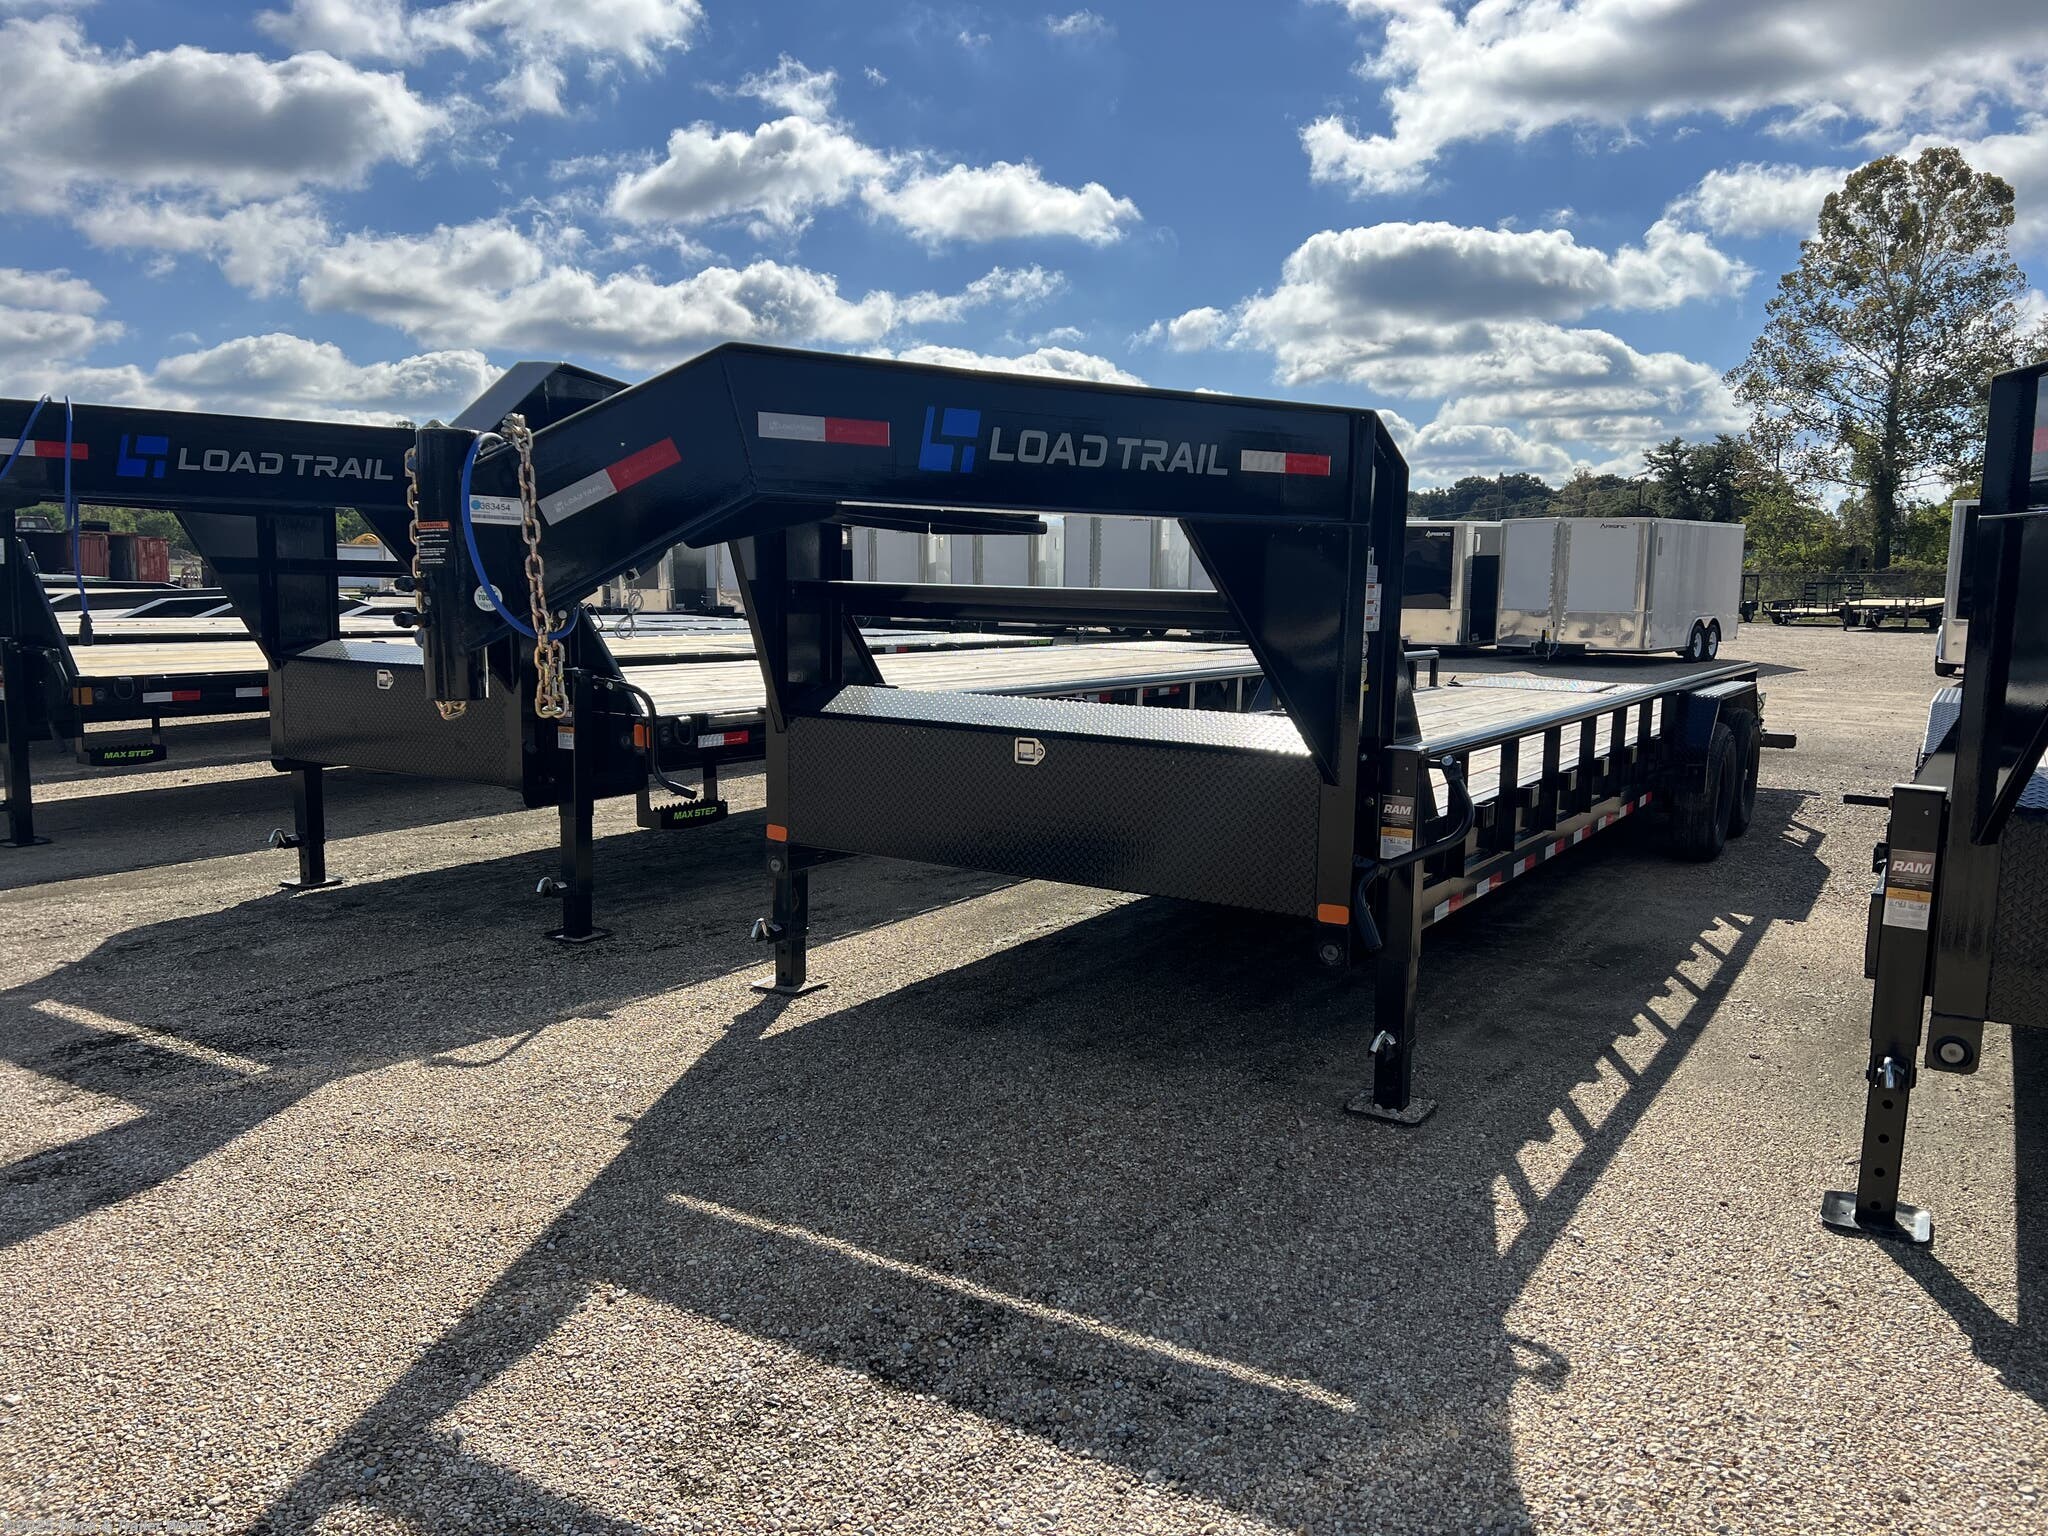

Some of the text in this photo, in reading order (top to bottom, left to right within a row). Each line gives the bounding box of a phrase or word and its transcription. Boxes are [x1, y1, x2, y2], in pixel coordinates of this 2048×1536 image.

[989, 427, 1228, 476] LOAD TRAIL
[177, 447, 394, 481] LOAD TRAIL
[104, 749, 154, 759] MAX STEP
[674, 807, 717, 820] MAX STEP
[1383, 803, 1412, 816] RAM
[1892, 860, 1933, 875] RAM
